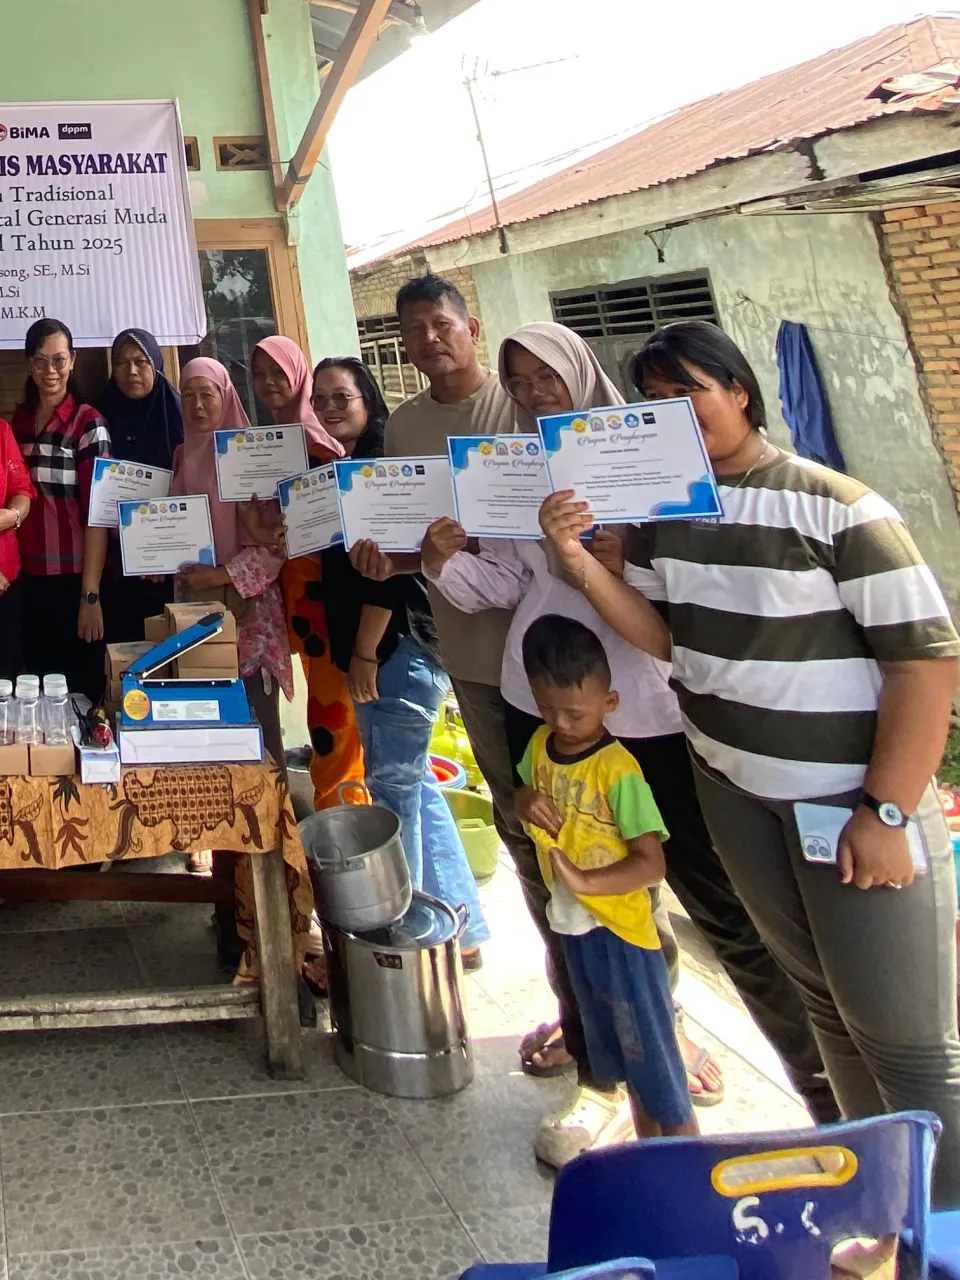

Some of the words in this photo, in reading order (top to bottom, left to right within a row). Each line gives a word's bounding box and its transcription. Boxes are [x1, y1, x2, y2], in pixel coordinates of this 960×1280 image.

[9, 126, 50, 140] BiMA
[61, 124, 89, 135] dppm
[25, 152, 168, 176] MASYARAKAT
[9, 183, 116, 203] Tradisional
[27, 208, 108, 227] Generasi
[114, 206, 168, 225] Muda
[10, 232, 76, 252] Tahun
[82, 237, 124, 256] 2025
[33, 264, 58, 278] SE.,
[61, 263, 91, 276] M.Si
